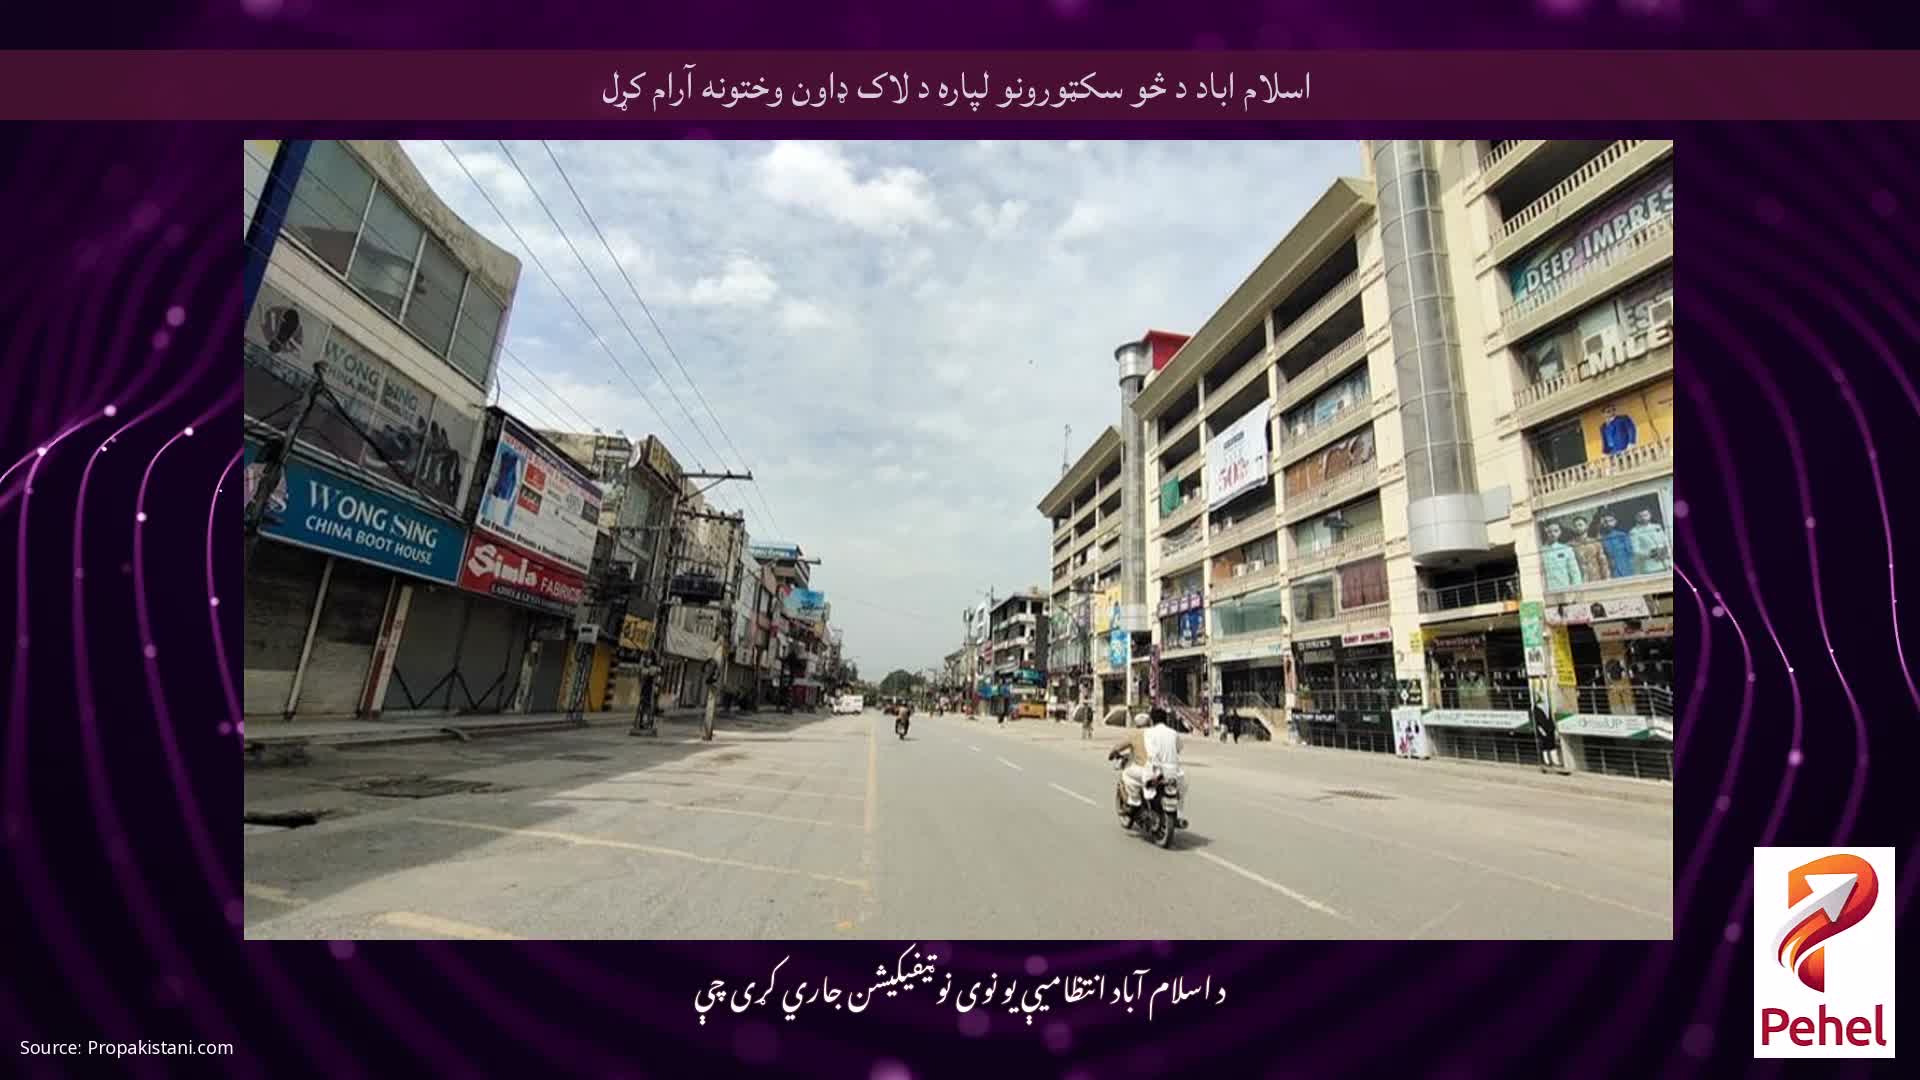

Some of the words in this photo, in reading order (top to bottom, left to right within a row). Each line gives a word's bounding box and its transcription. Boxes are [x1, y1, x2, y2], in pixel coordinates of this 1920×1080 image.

[1526, 247, 1576, 294] DEEP
[309, 480, 388, 531] WONG
[390, 512, 439, 549] SING
[305, 515, 353, 541] CHINA
[355, 530, 394, 552] BOOT
[394, 543, 433, 566] HOUSE
